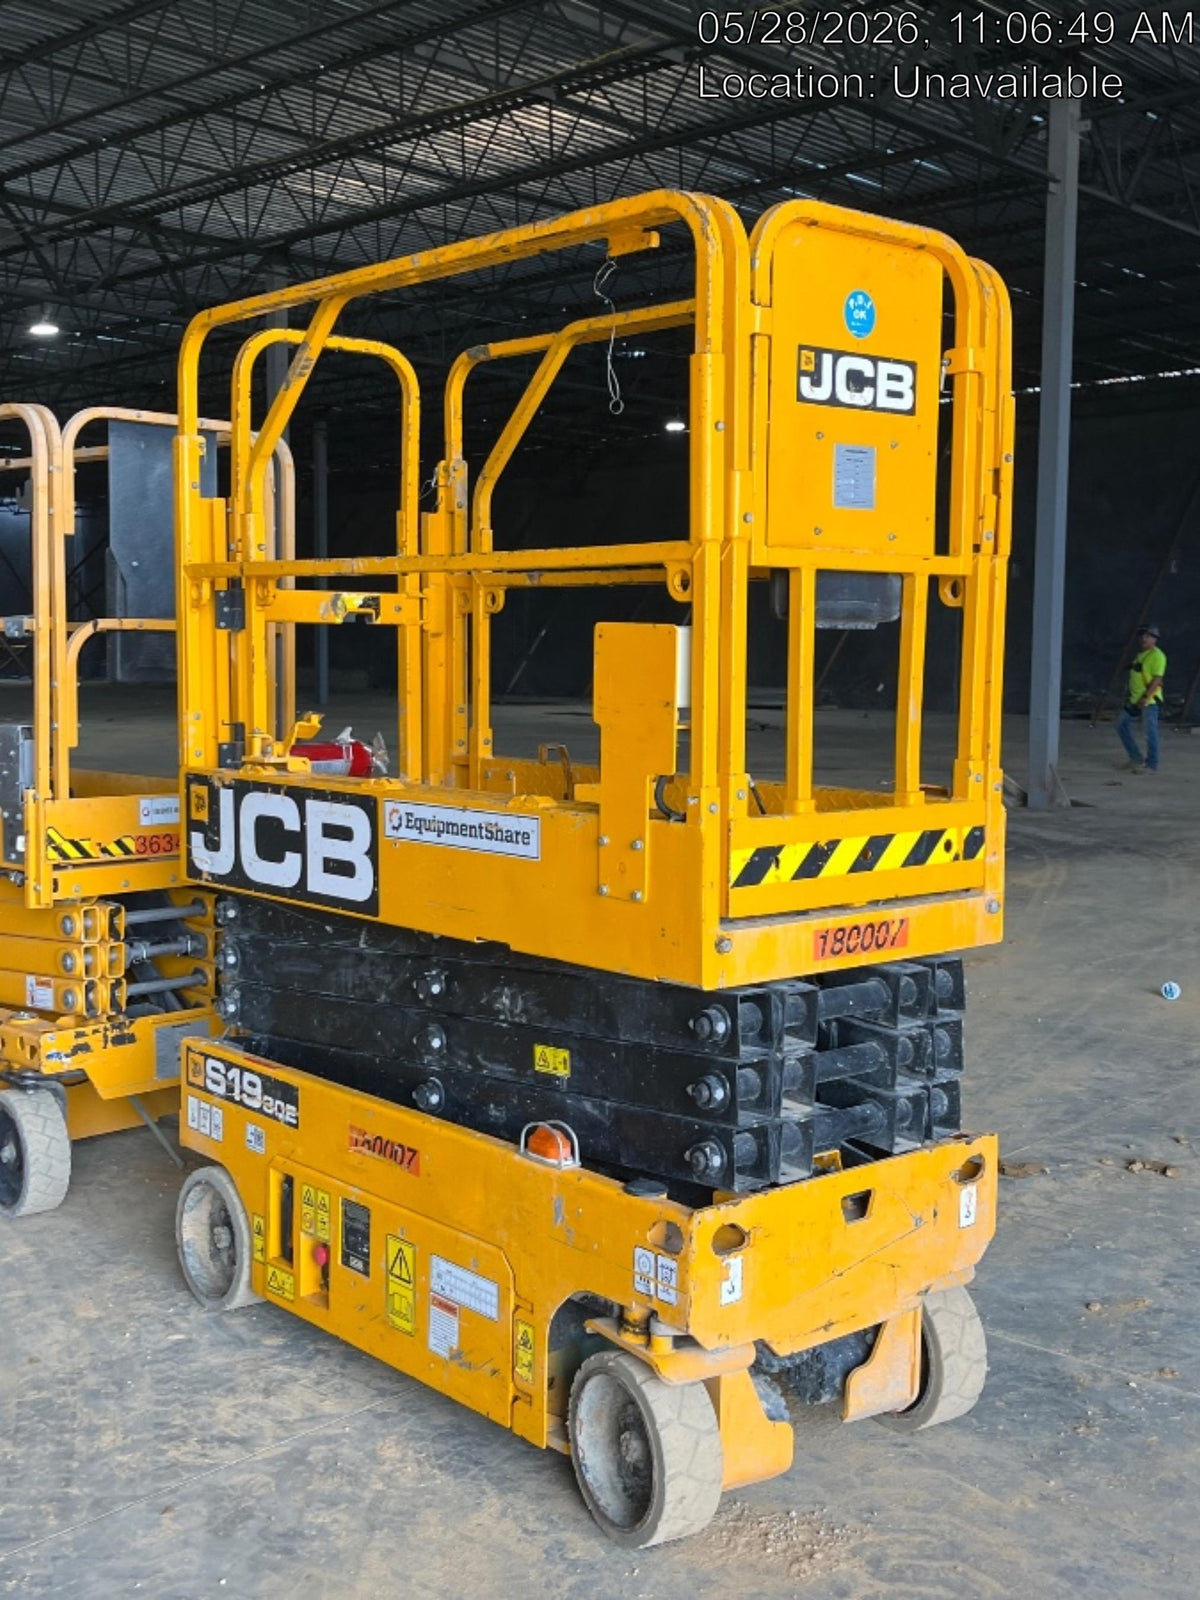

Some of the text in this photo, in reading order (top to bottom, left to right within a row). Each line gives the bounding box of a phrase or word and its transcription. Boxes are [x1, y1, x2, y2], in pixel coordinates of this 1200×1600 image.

[799, 353, 915, 411] JCB
[190, 787, 374, 902] JCB
[405, 811, 532, 846] EquipmentShare
